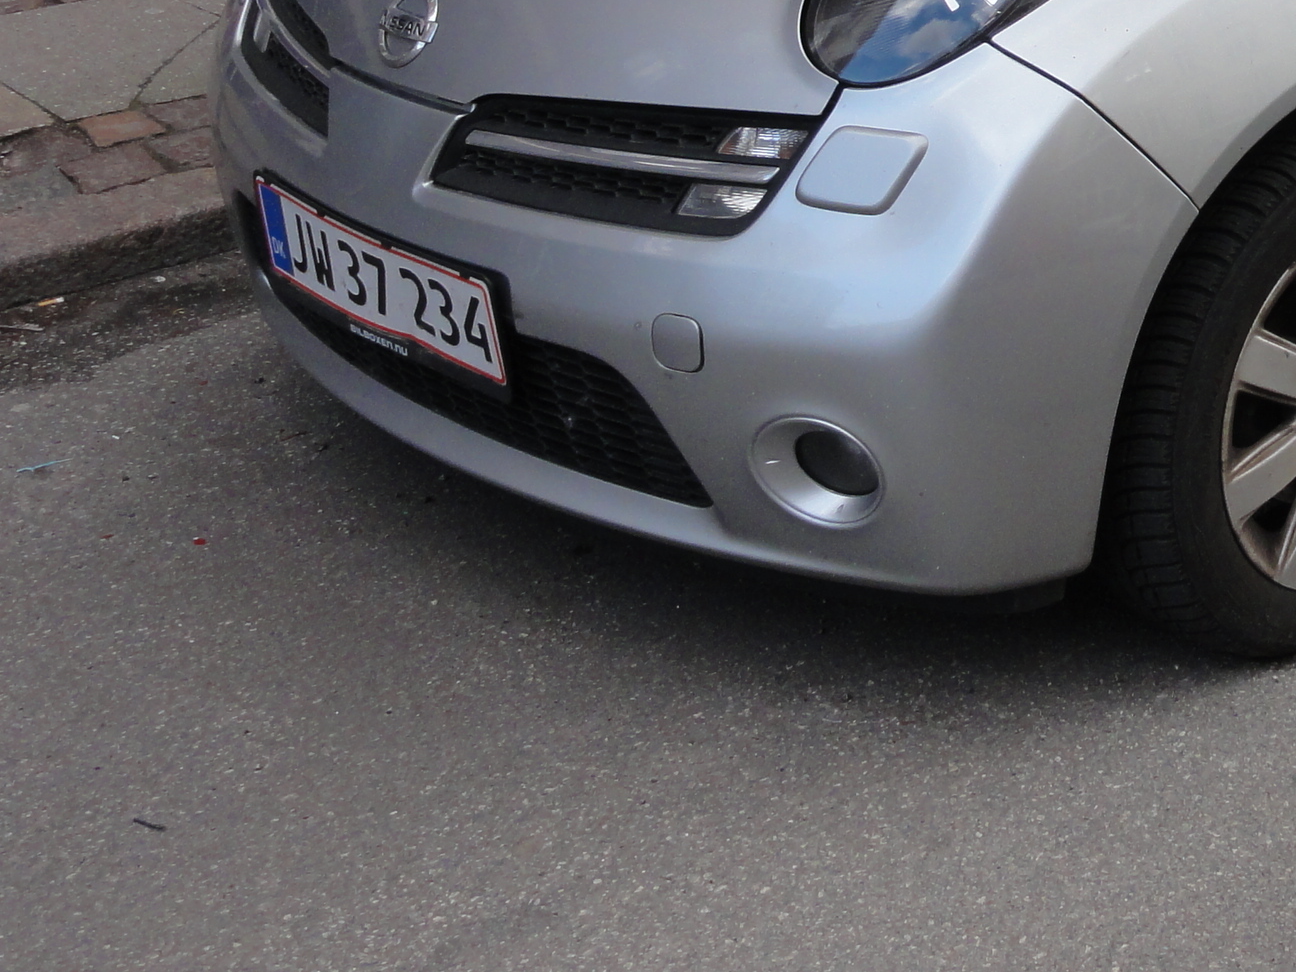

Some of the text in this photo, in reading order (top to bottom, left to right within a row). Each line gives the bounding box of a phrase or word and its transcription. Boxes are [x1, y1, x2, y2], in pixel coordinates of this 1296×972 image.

[382, 9, 425, 37] SSAN
[271, 236, 286, 259] DK
[294, 213, 493, 364] JW 37 234
